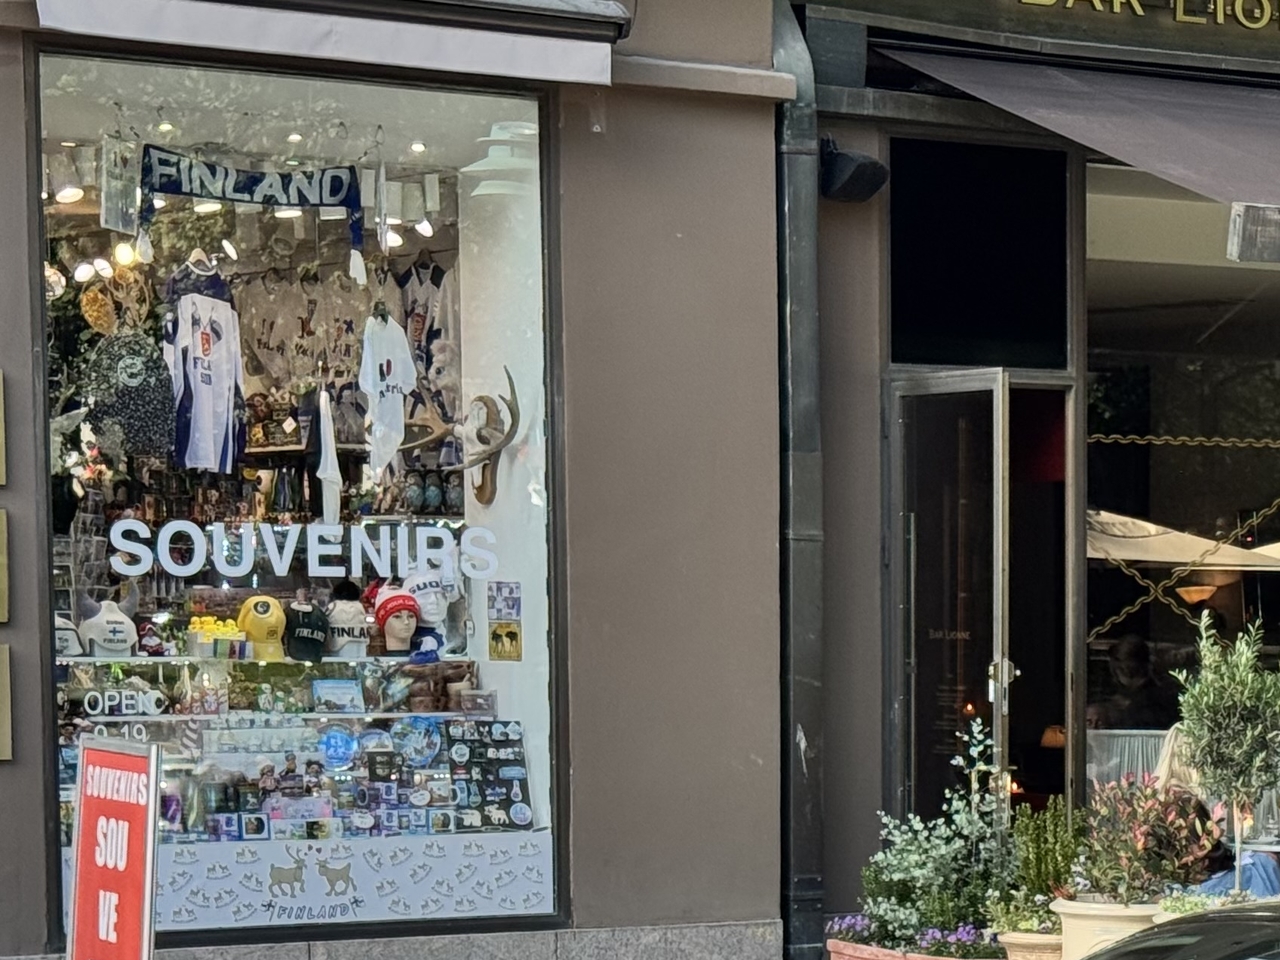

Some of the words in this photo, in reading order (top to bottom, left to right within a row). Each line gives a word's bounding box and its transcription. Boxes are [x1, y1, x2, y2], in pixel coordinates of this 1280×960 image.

[149, 147, 351, 205] FINLAND
[109, 518, 500, 580] SOUVENIRS
[84, 691, 155, 715] OPEN
[87, 764, 148, 806] SOUVENIRS
[95, 815, 129, 872] SOU
[98, 889, 119, 944] VE
[277, 902, 350, 920] FINLAND
